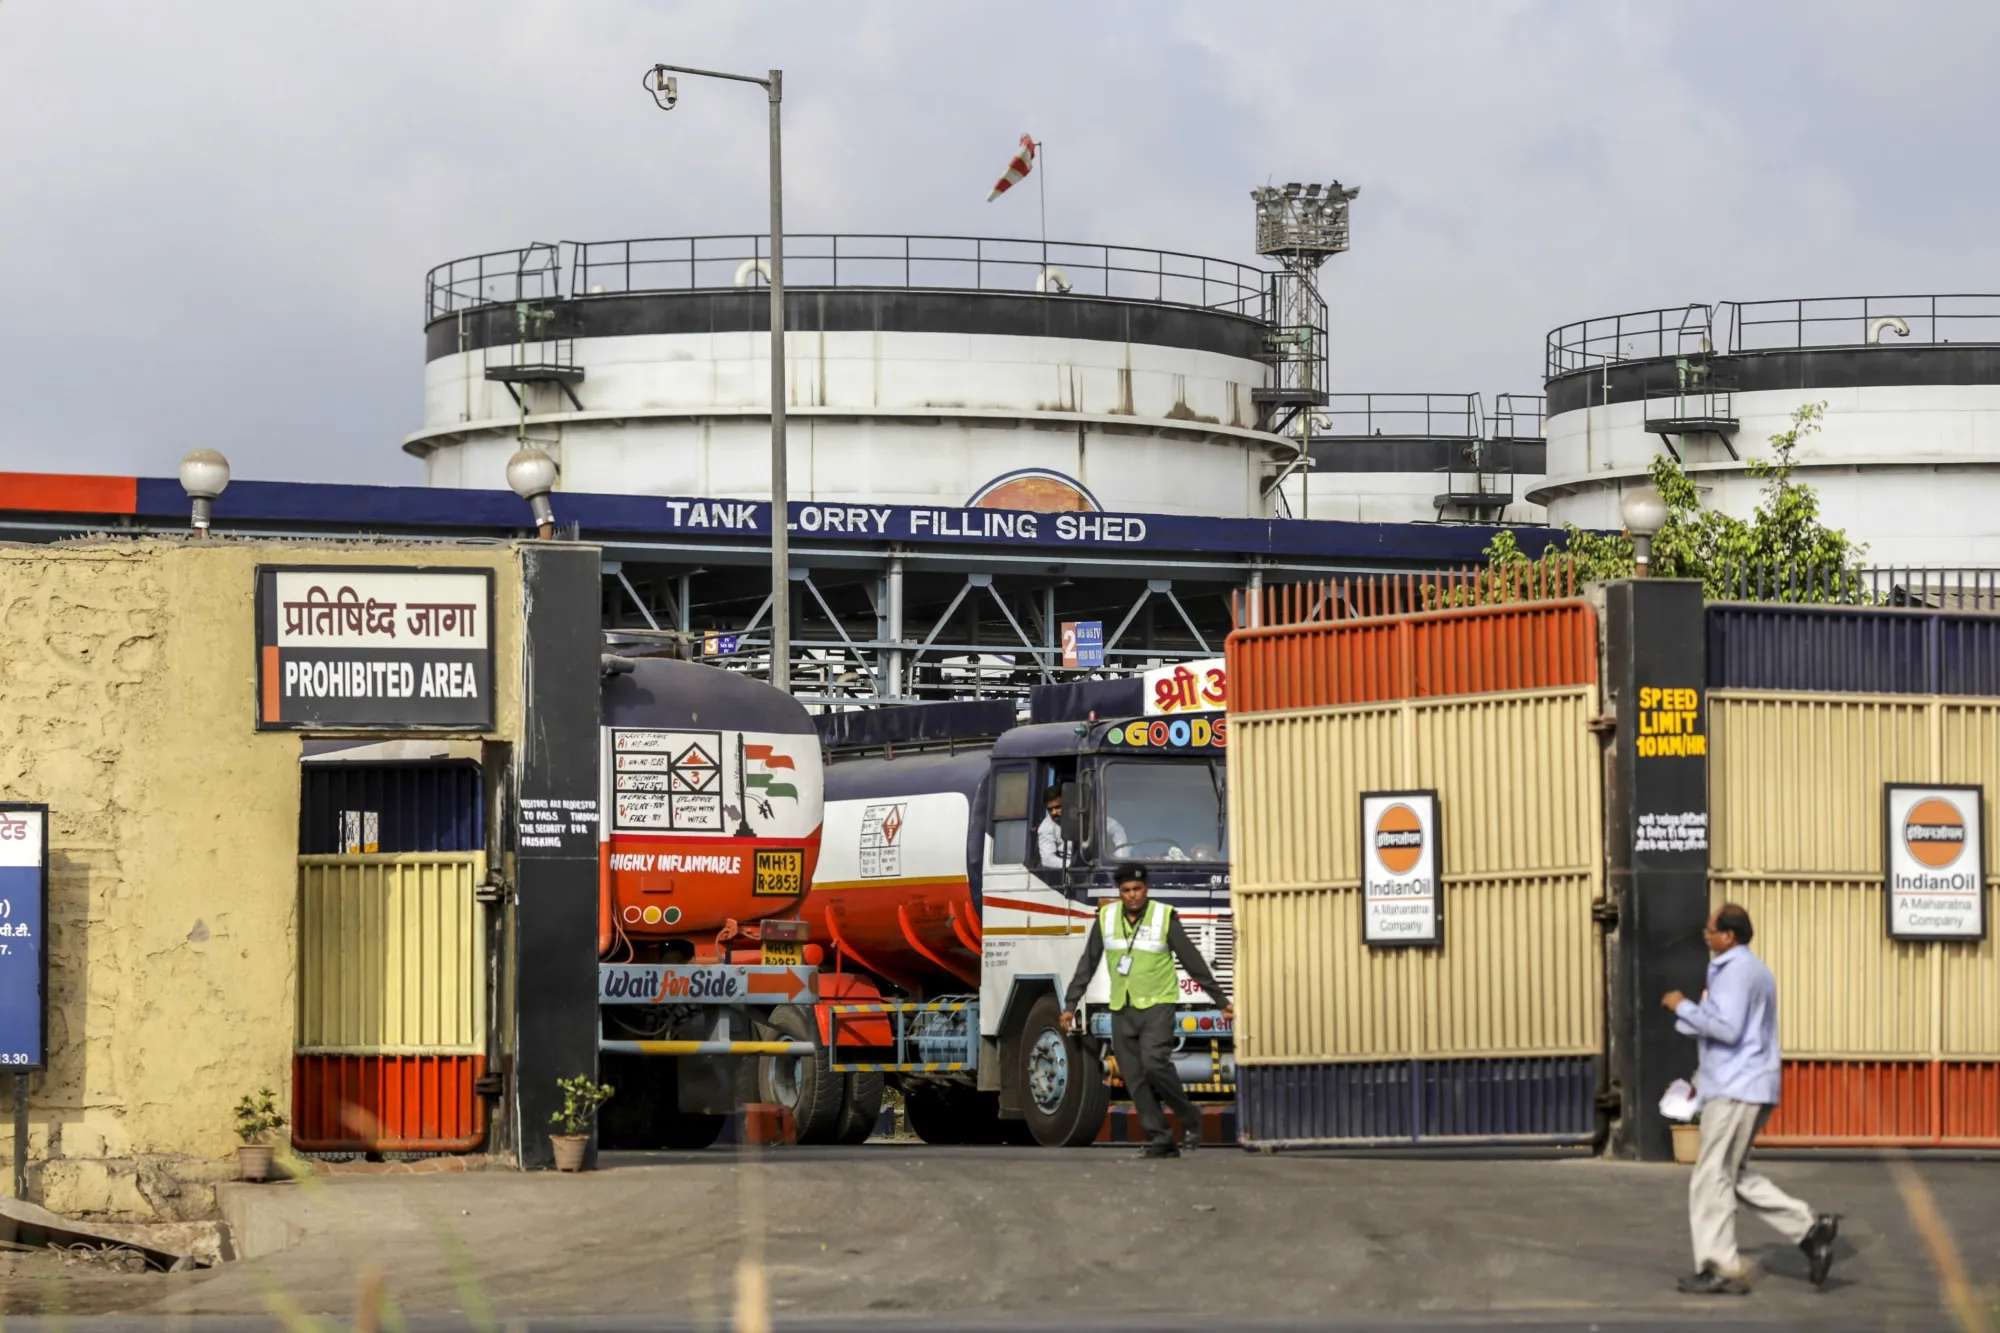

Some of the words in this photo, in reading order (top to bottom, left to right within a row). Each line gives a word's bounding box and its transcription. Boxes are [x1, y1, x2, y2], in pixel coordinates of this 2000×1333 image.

[666, 501, 758, 529] TANK
[910, 510, 1038, 539] FILLING
[1055, 515, 1147, 542] SHED
[405, 602, 477, 637] जागा
[1063, 630, 1077, 659] 2
[285, 661, 414, 698] PROHIBITED
[419, 662, 478, 698] AREA
[1154, 666, 1202, 714] श्री
[1639, 686, 1698, 711] SPEED
[1639, 711, 1698, 735] LIMIT
[1125, 718, 1226, 748] GOODS
[691, 771, 700, 784] 3
[523, 811, 534, 820] TO
[536, 811, 558, 820] PASS
[570, 812, 600, 822] THROUGH
[519, 824, 535, 834] THE
[535, 824, 566, 834] SECURITY
[570, 824, 588, 834] FOR
[521, 836, 562, 848] FRISKING
[610, 853, 656, 872] HIGHLY
[657, 854, 741, 874] INFLAMMABLE
[1369, 878, 1431, 896] IndianOil
[1896, 873, 1975, 890] IndianOil
[1373, 904, 1380, 915] A
[1382, 903, 1430, 916] Maharatna
[1900, 898, 1910, 910] A
[1912, 898, 1972, 910] Maharatna
[1380, 918, 1423, 933] Company
[1908, 914, 1964, 928] Company
[604, 970, 658, 998] Wait
[650, 969, 690, 1003] for
[689, 970, 738, 998] Side
